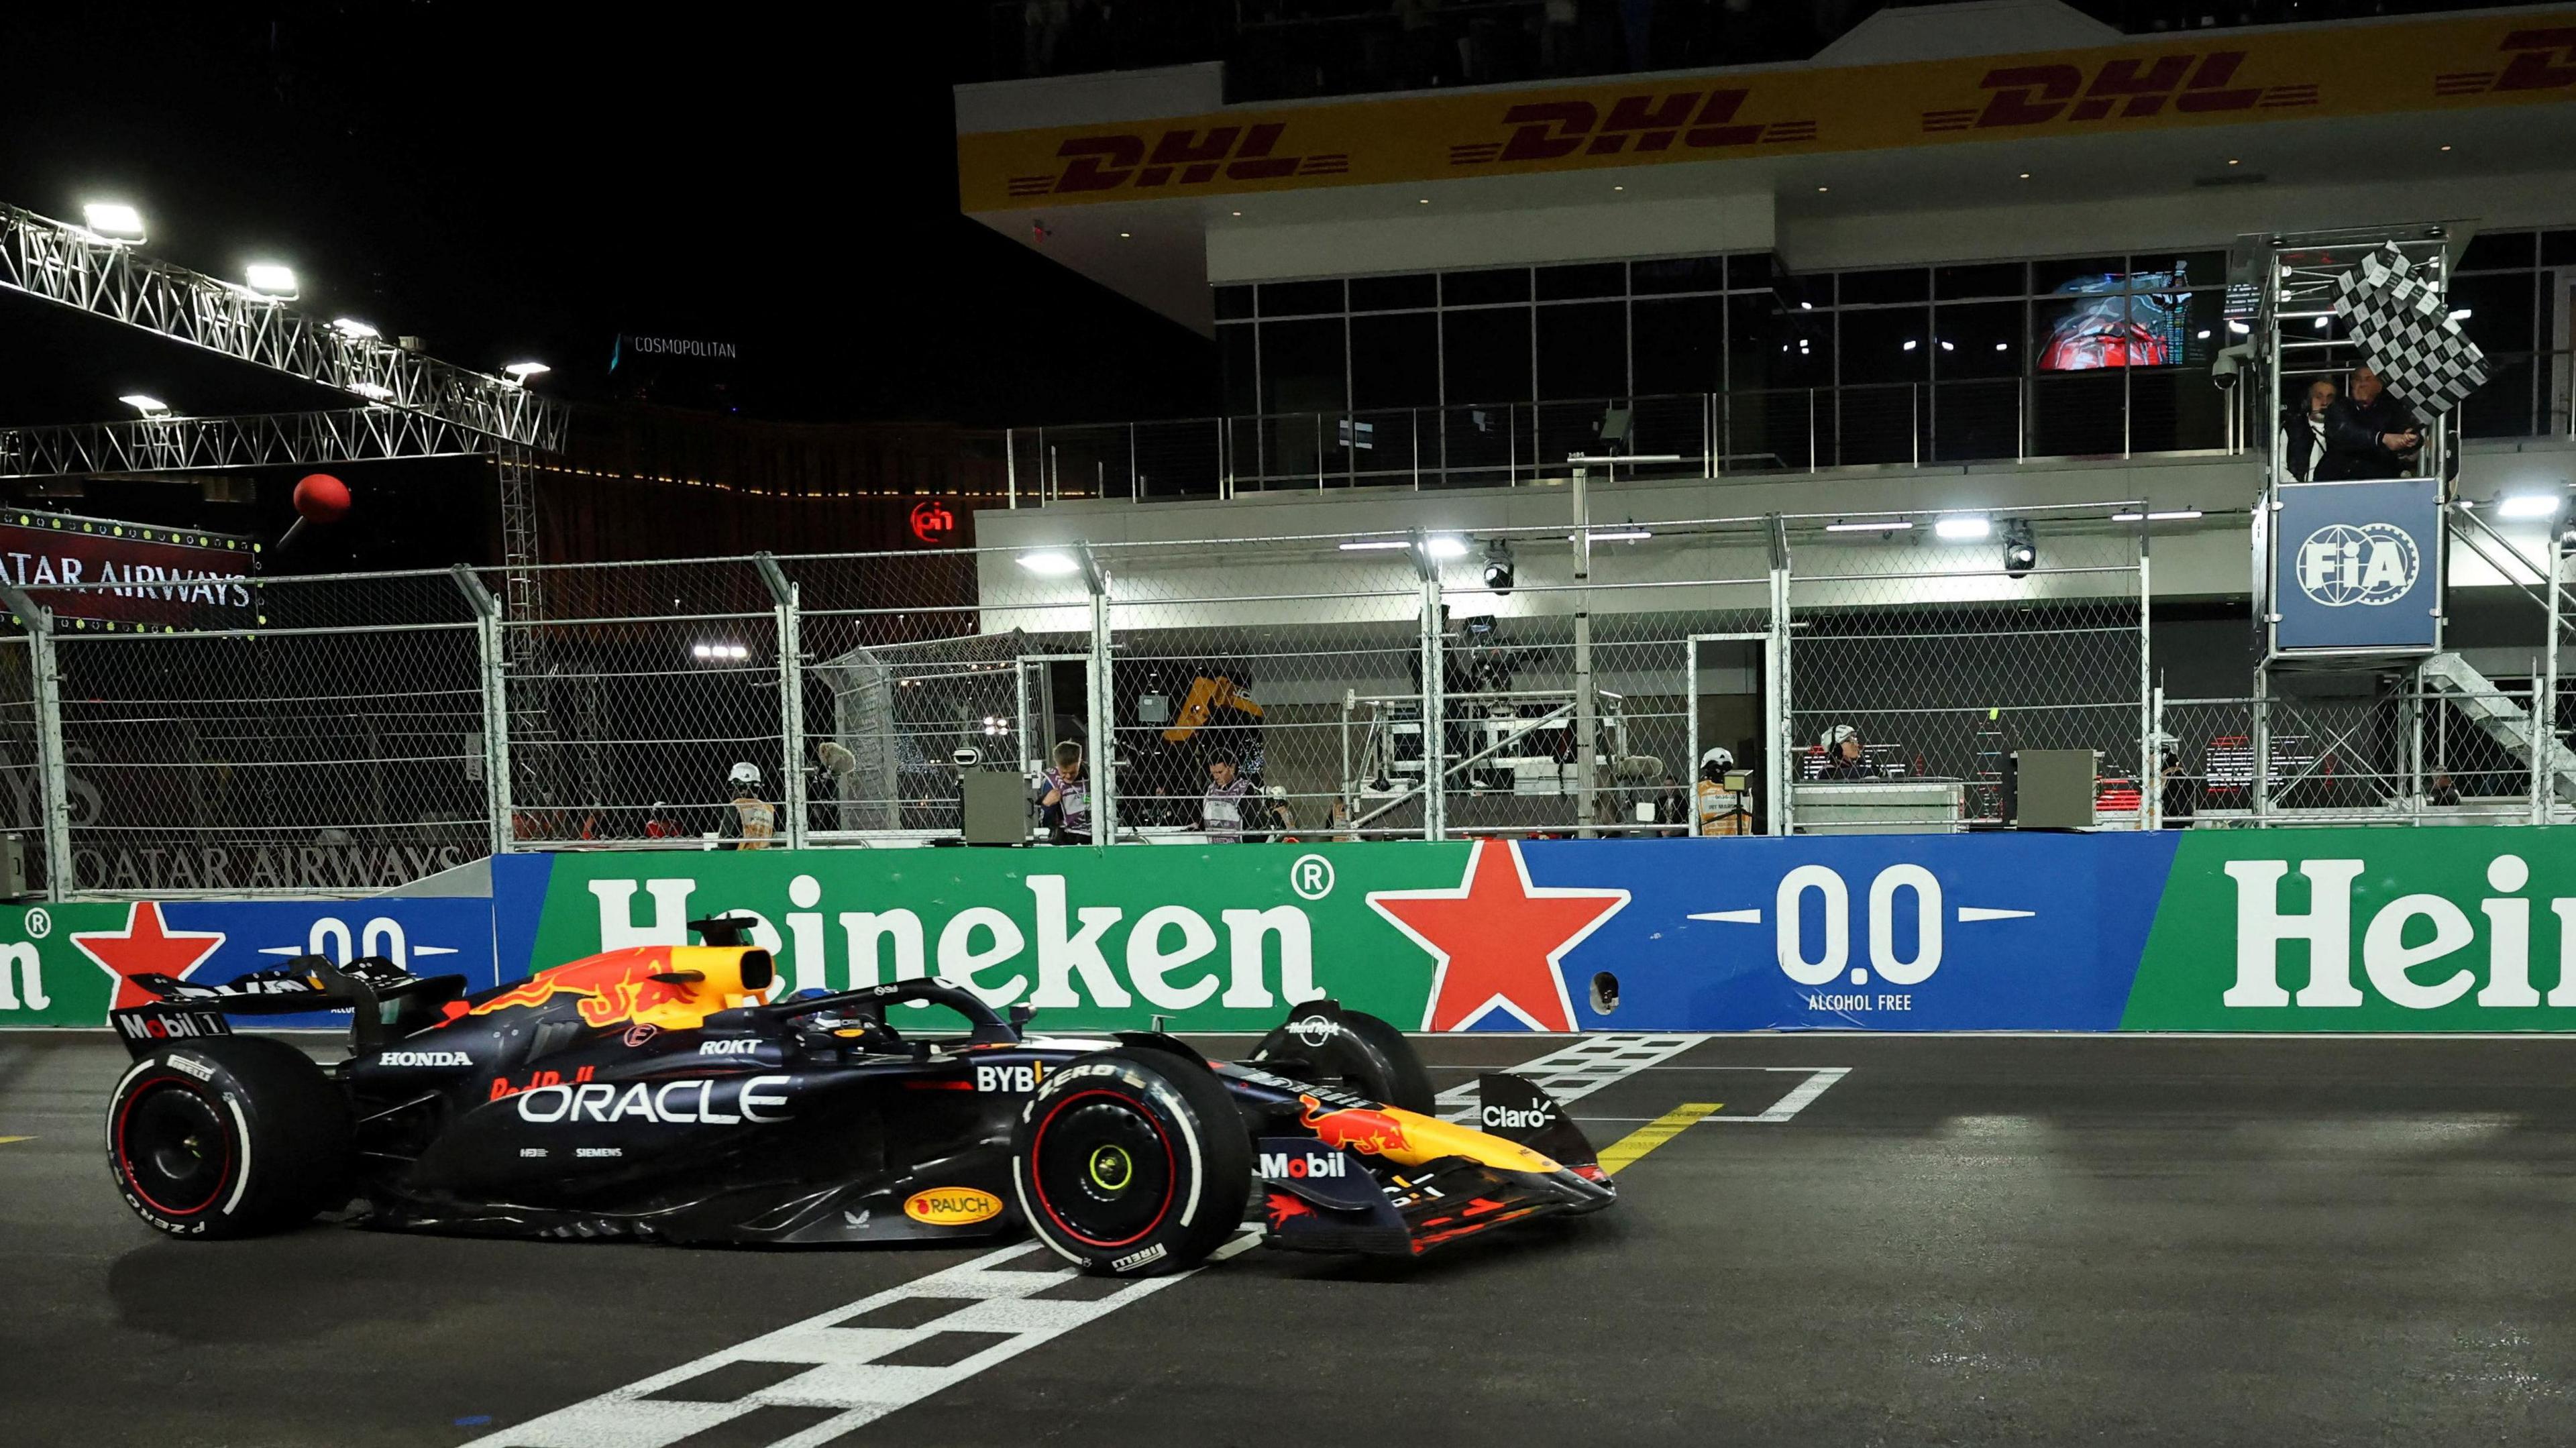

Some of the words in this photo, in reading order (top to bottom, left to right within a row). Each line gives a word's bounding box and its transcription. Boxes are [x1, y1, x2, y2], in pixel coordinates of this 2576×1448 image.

[1975, 52, 2263, 128] DHL
[1499, 89, 1766, 162] DHL
[1054, 123, 1302, 193] DHL
[635, 336, 736, 359] COSMOPOLITAN
[98, 561, 250, 607] AIRWAYS
[251, 847, 460, 888] AIRWAYS
[1776, 864, 1942, 985] 0.0
[2223, 854, 2576, 1009] Hei
[1809, 994, 1872, 1011] ALCOHOL
[1878, 994, 1912, 1011] FREE
[119, 1012, 201, 1040] Mobil
[203, 1013, 220, 1034] 1
[378, 1052, 473, 1067] HONDA
[700, 1039, 762, 1056] ROKT
[1037, 1064, 1117, 1101] ZERO
[517, 1075, 794, 1125] ORACLE
[1483, 1105, 1545, 1128] Claro
[576, 1148, 623, 1158] SIEMENS
[1260, 1152, 1346, 1178] Mobil
[126, 1193, 186, 1234] ZERO
[930, 1197, 990, 1213] RAUCH
[1111, 1243, 1167, 1272] PIRELLI
